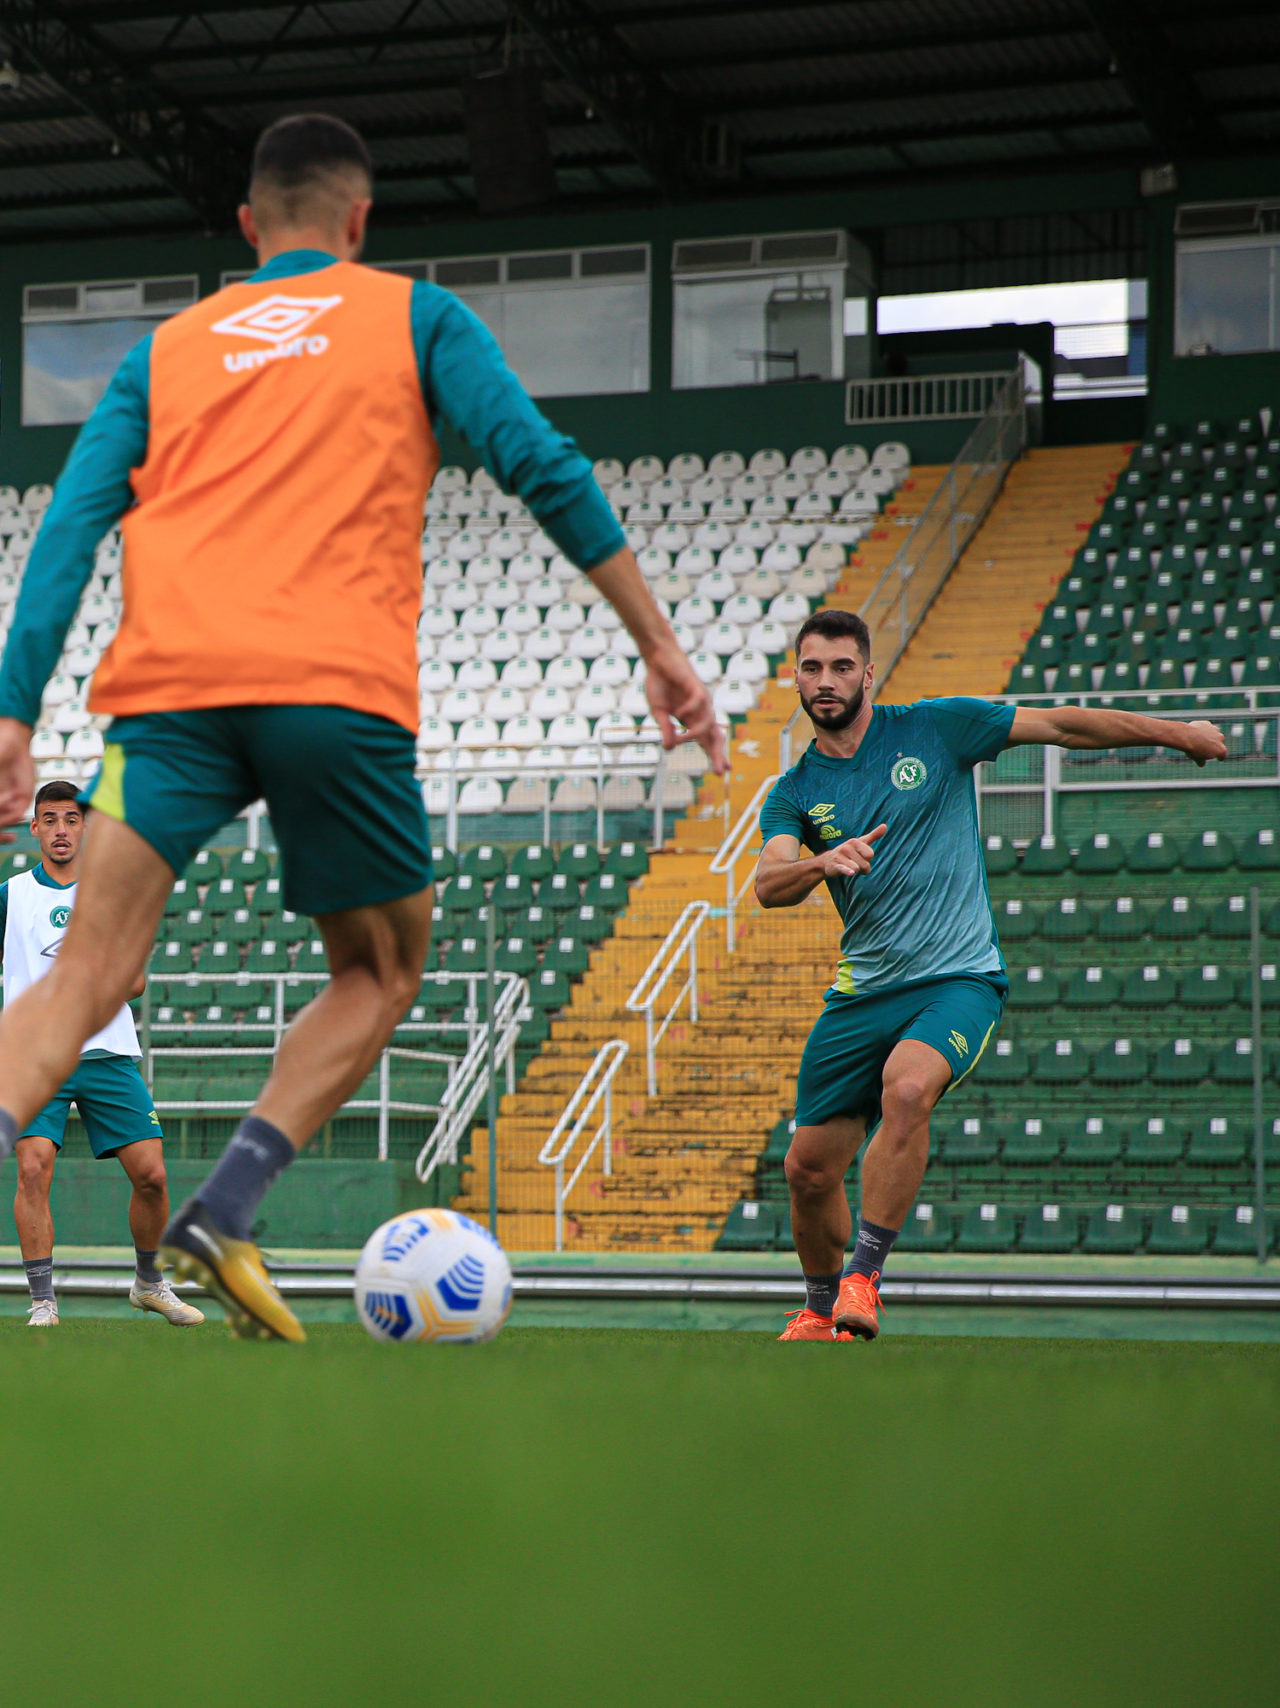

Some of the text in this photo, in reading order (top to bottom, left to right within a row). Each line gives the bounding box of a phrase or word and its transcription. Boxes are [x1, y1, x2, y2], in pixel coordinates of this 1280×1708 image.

[223, 335, 329, 373] umbro
[813, 814, 835, 825] umbro
[948, 1037, 963, 1058] umbro
